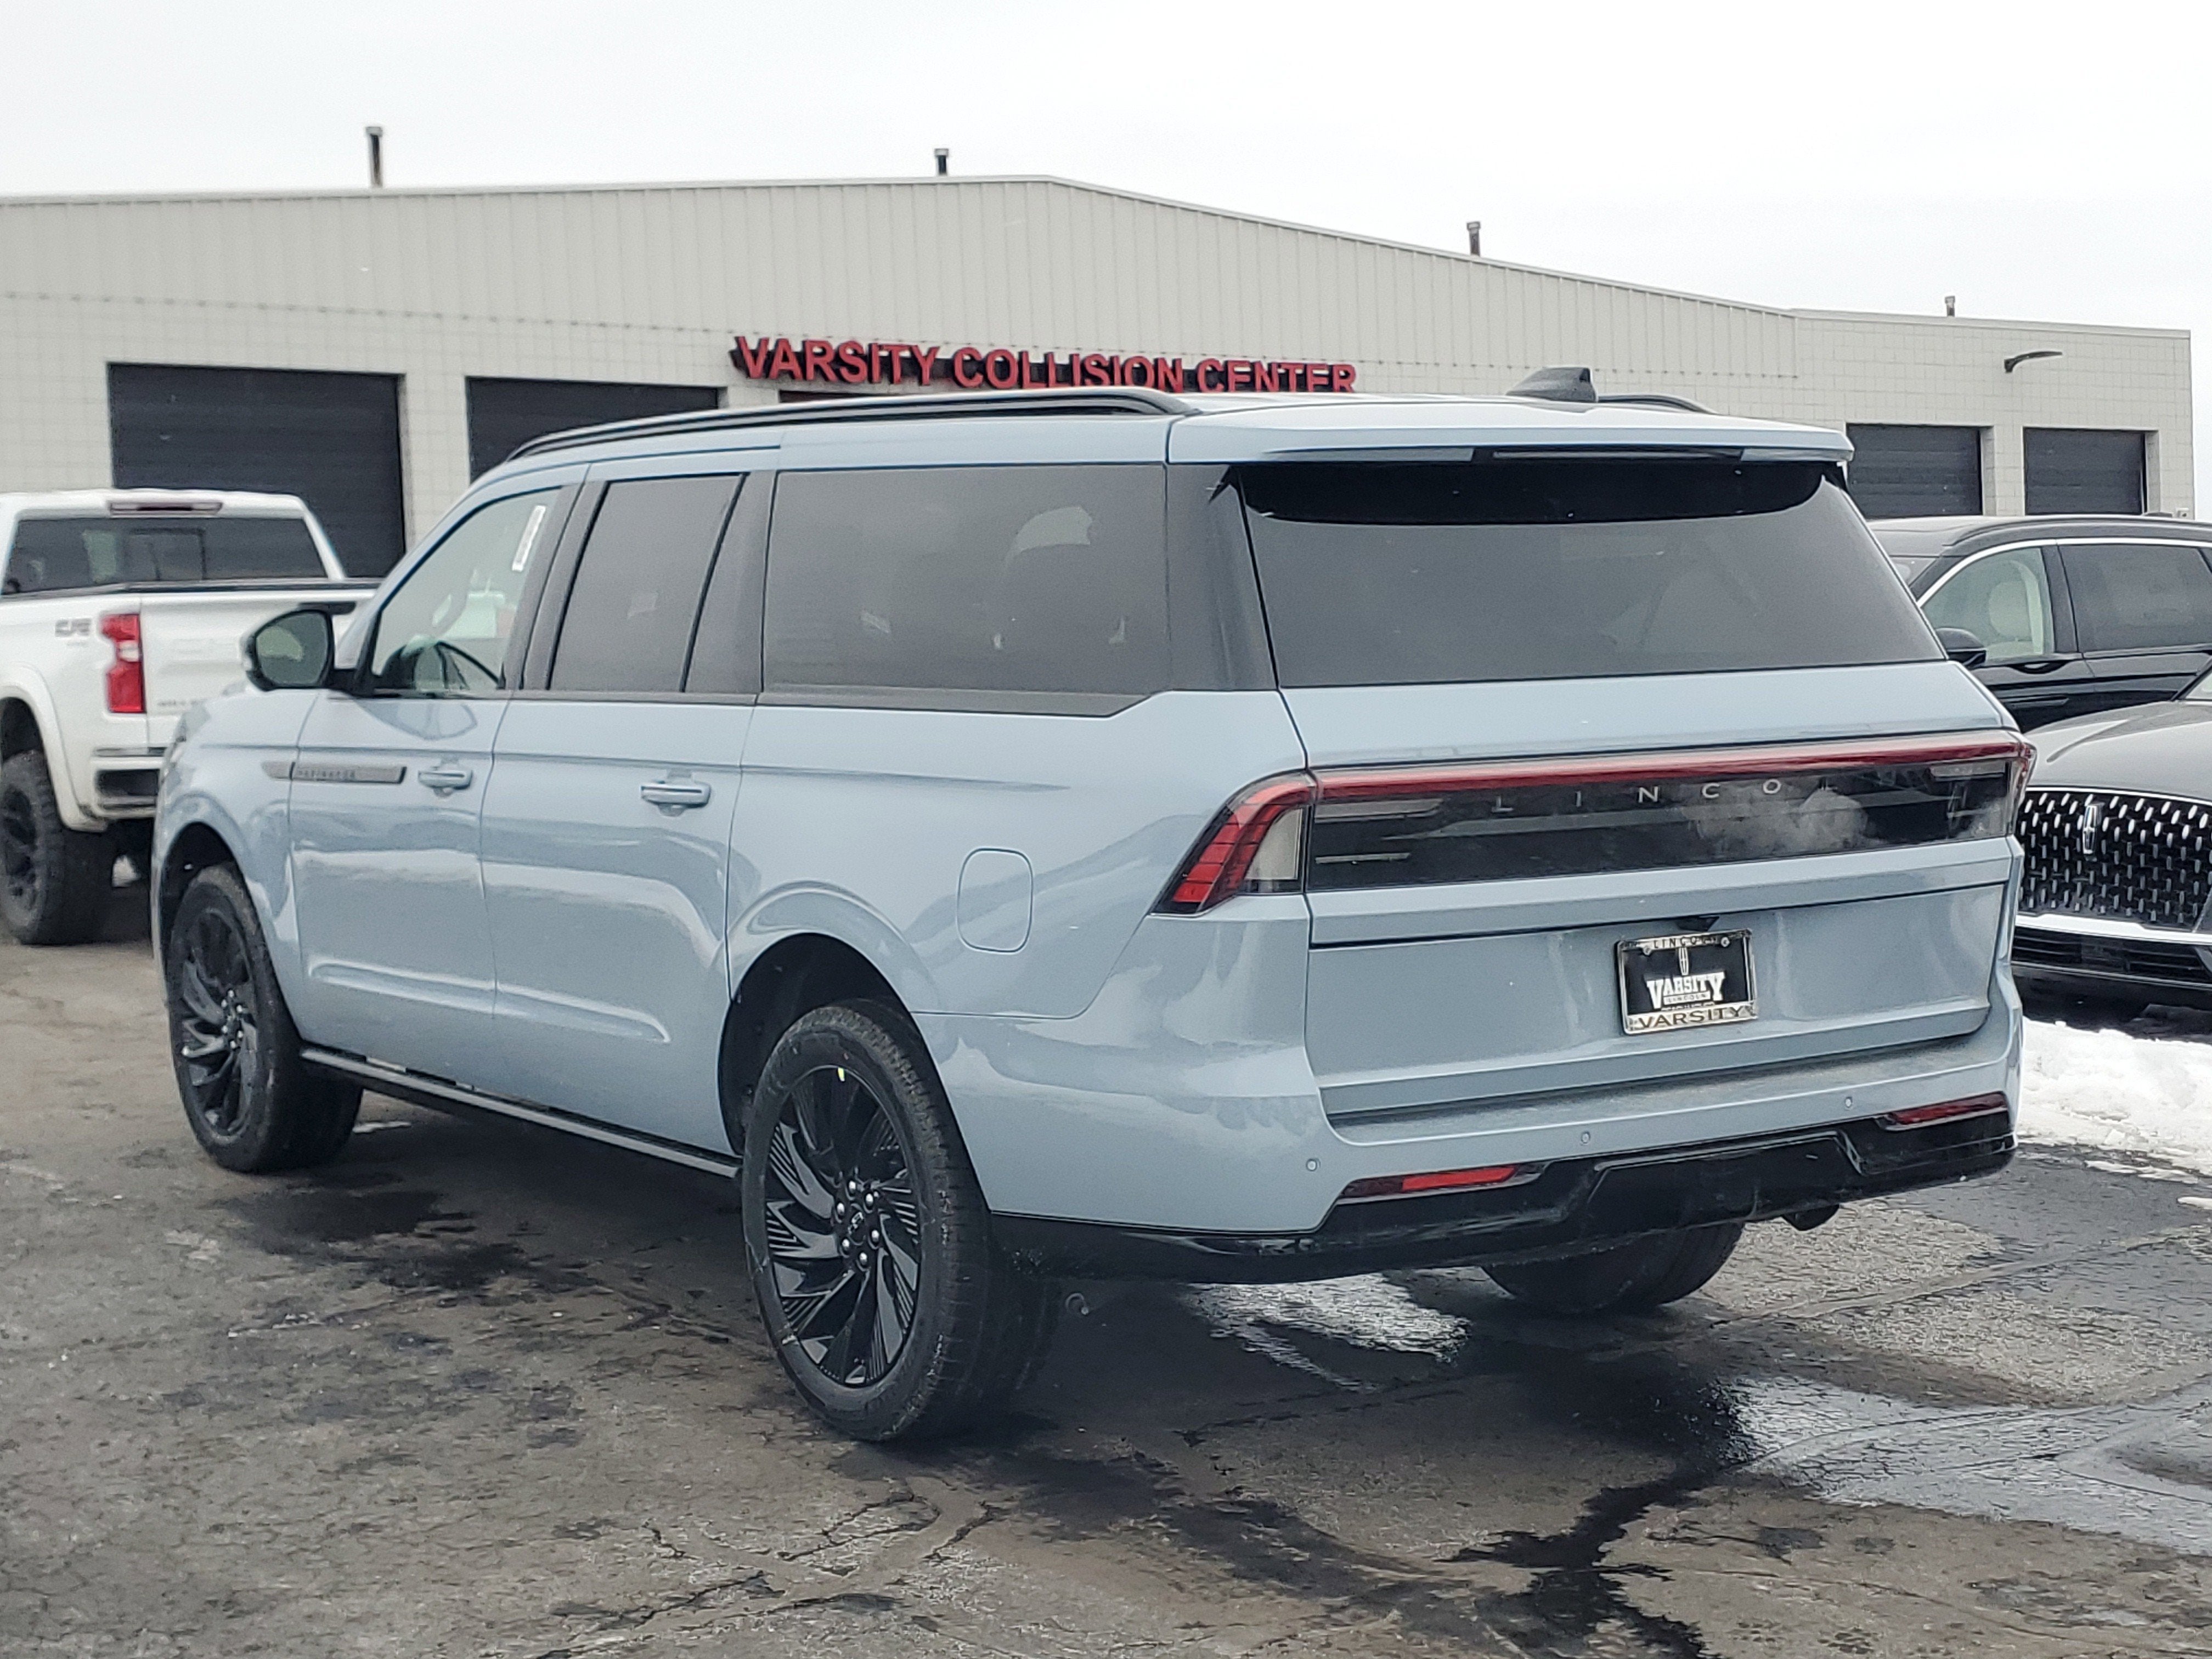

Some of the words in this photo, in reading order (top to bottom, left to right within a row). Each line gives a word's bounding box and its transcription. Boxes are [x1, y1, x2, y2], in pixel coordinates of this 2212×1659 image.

[736, 336, 940, 386] VARSITY
[952, 346, 1183, 393] COLLISION
[1197, 358, 1357, 393] CENTER
[1491, 770, 1896, 814] LINCOL
[1646, 971, 1725, 1009] VARSITY
[1639, 1005, 1743, 1028] VARSITY
